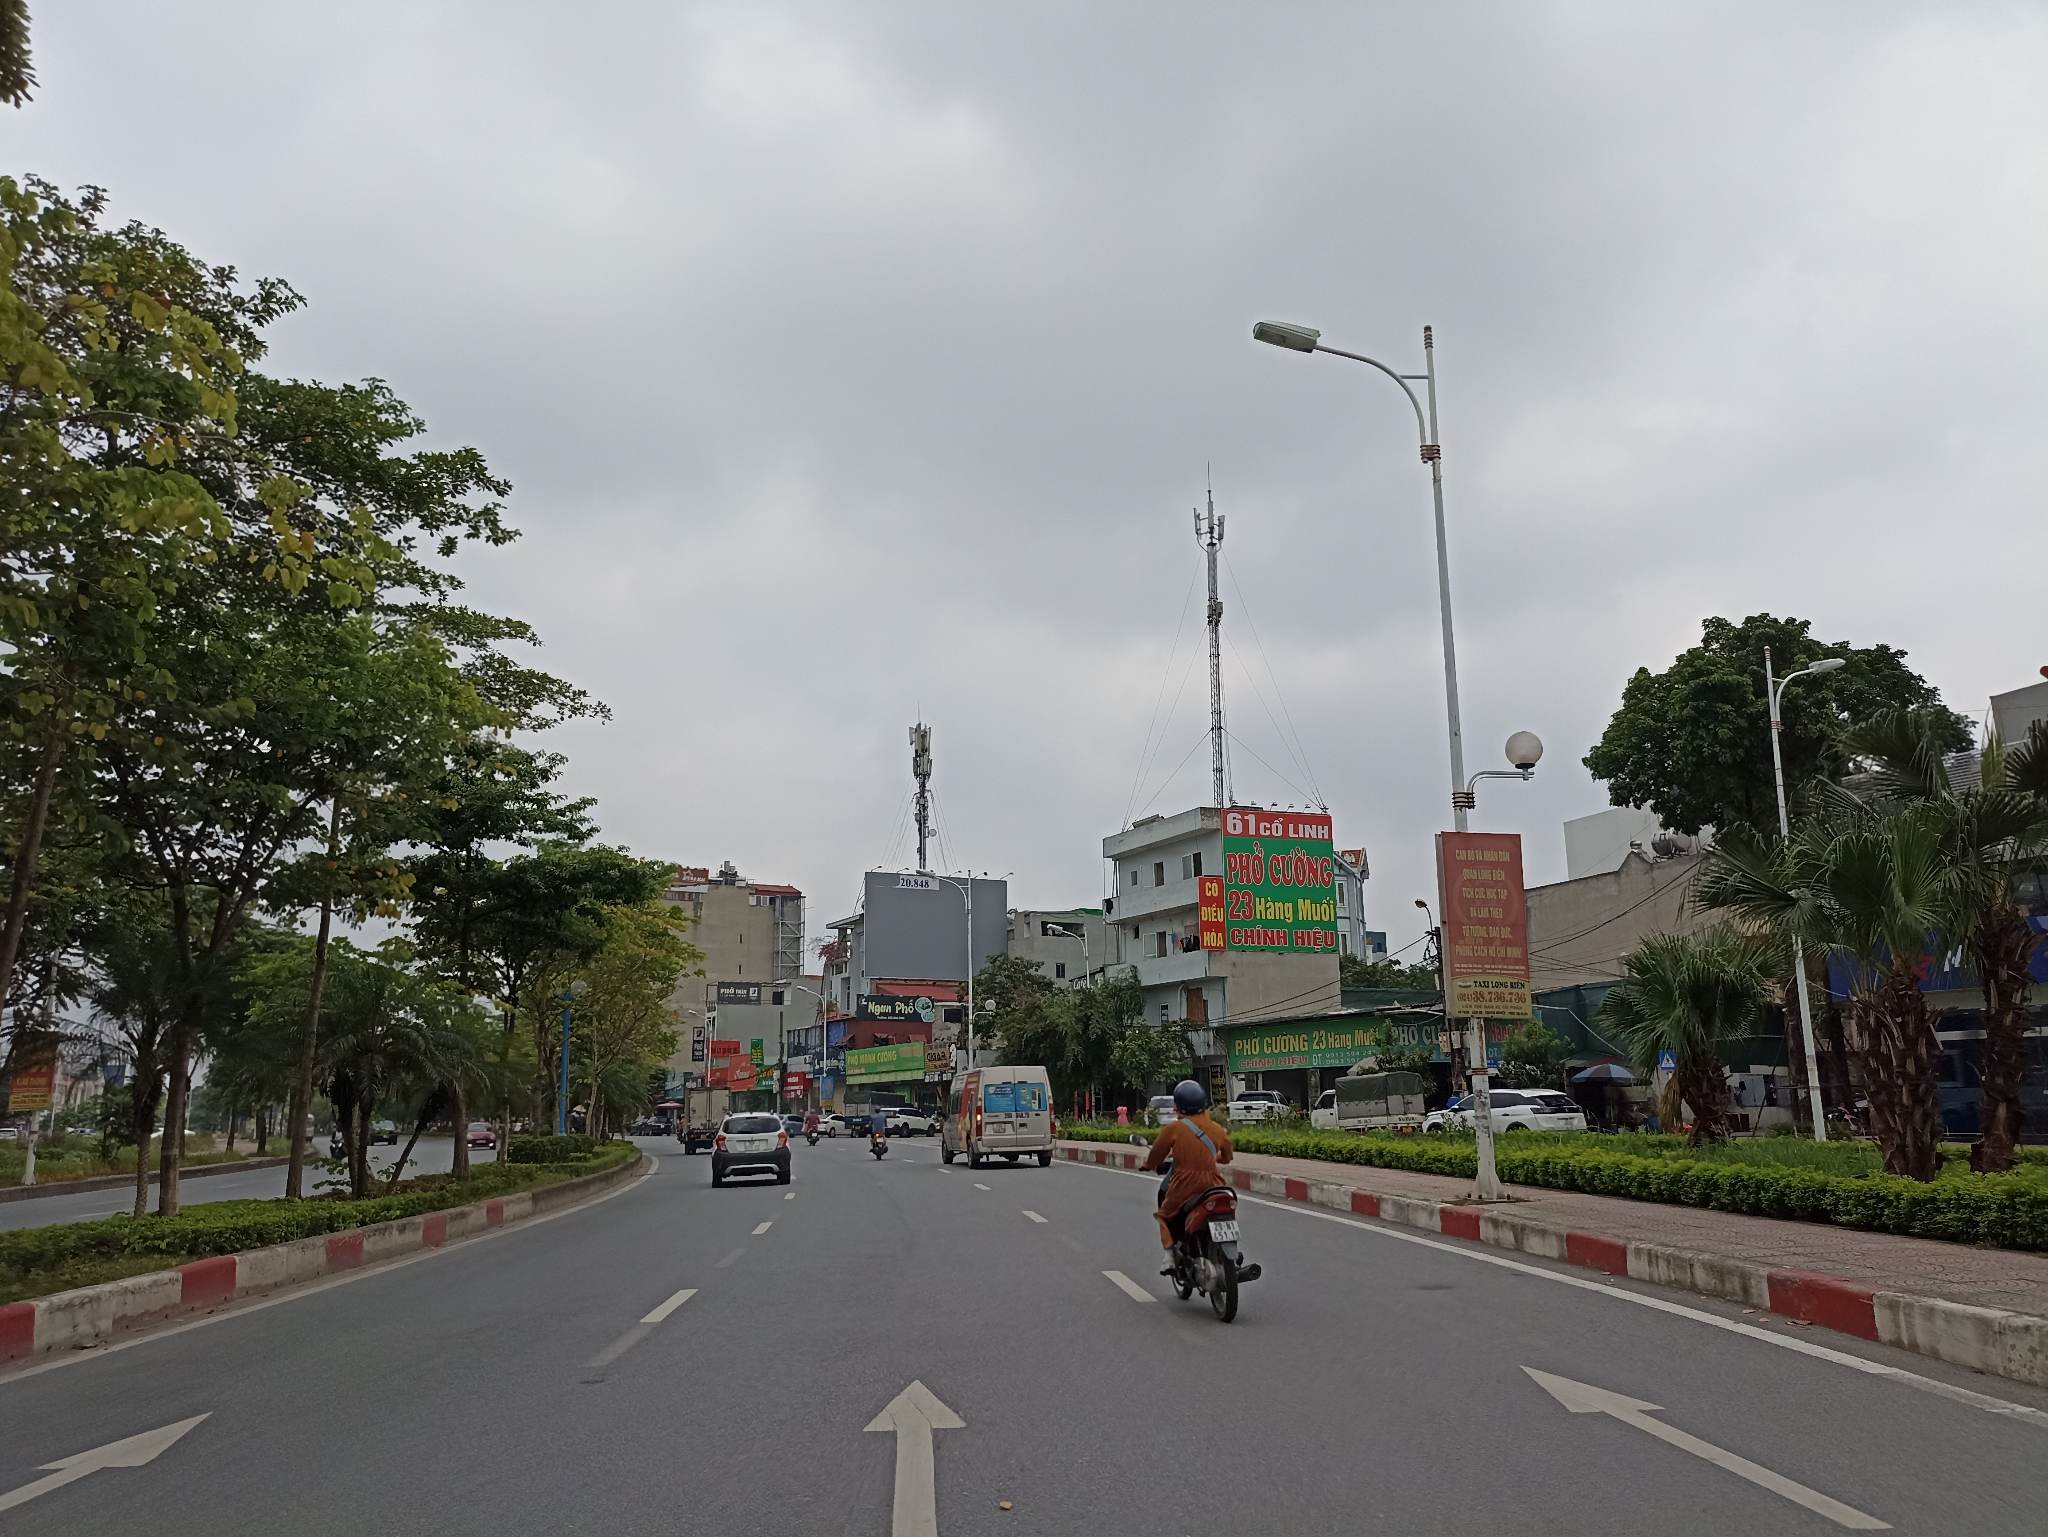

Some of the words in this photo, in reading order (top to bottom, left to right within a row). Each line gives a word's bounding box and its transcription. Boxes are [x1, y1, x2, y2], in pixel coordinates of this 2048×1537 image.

[1226, 812, 1256, 835] 61
[1288, 823, 1329, 839] LINH
[1226, 841, 1265, 885] PHỞ
[1268, 847, 1333, 889] CƯỜNG
[900, 877, 930, 889] 20.848
[1205, 879, 1219, 897] CÓ
[1228, 890, 1254, 920] 23
[1255, 896, 1294, 923] Hàng
[1297, 896, 1335, 922] Muối
[1203, 928, 1224, 947] HÒA
[1230, 925, 1288, 946] CHÍNH
[1293, 927, 1336, 952] HIỆU
[1473, 980, 1490, 988] TAXI
[1491, 980, 1509, 989] LONG
[867, 1001, 892, 1015] Ngan
[895, 999, 915, 1014] Phố
[1235, 1032, 1260, 1056] PHỞ
[1263, 1031, 1309, 1054] CƯỜNG
[1312, 1030, 1327, 1050] 23
[1327, 1031, 1352, 1050] Hàng
[1354, 1025, 1379, 1047] Muố
[1239, 1056, 1275, 1069] CHÍNH
[1278, 1055, 1308, 1068] HIỆU
